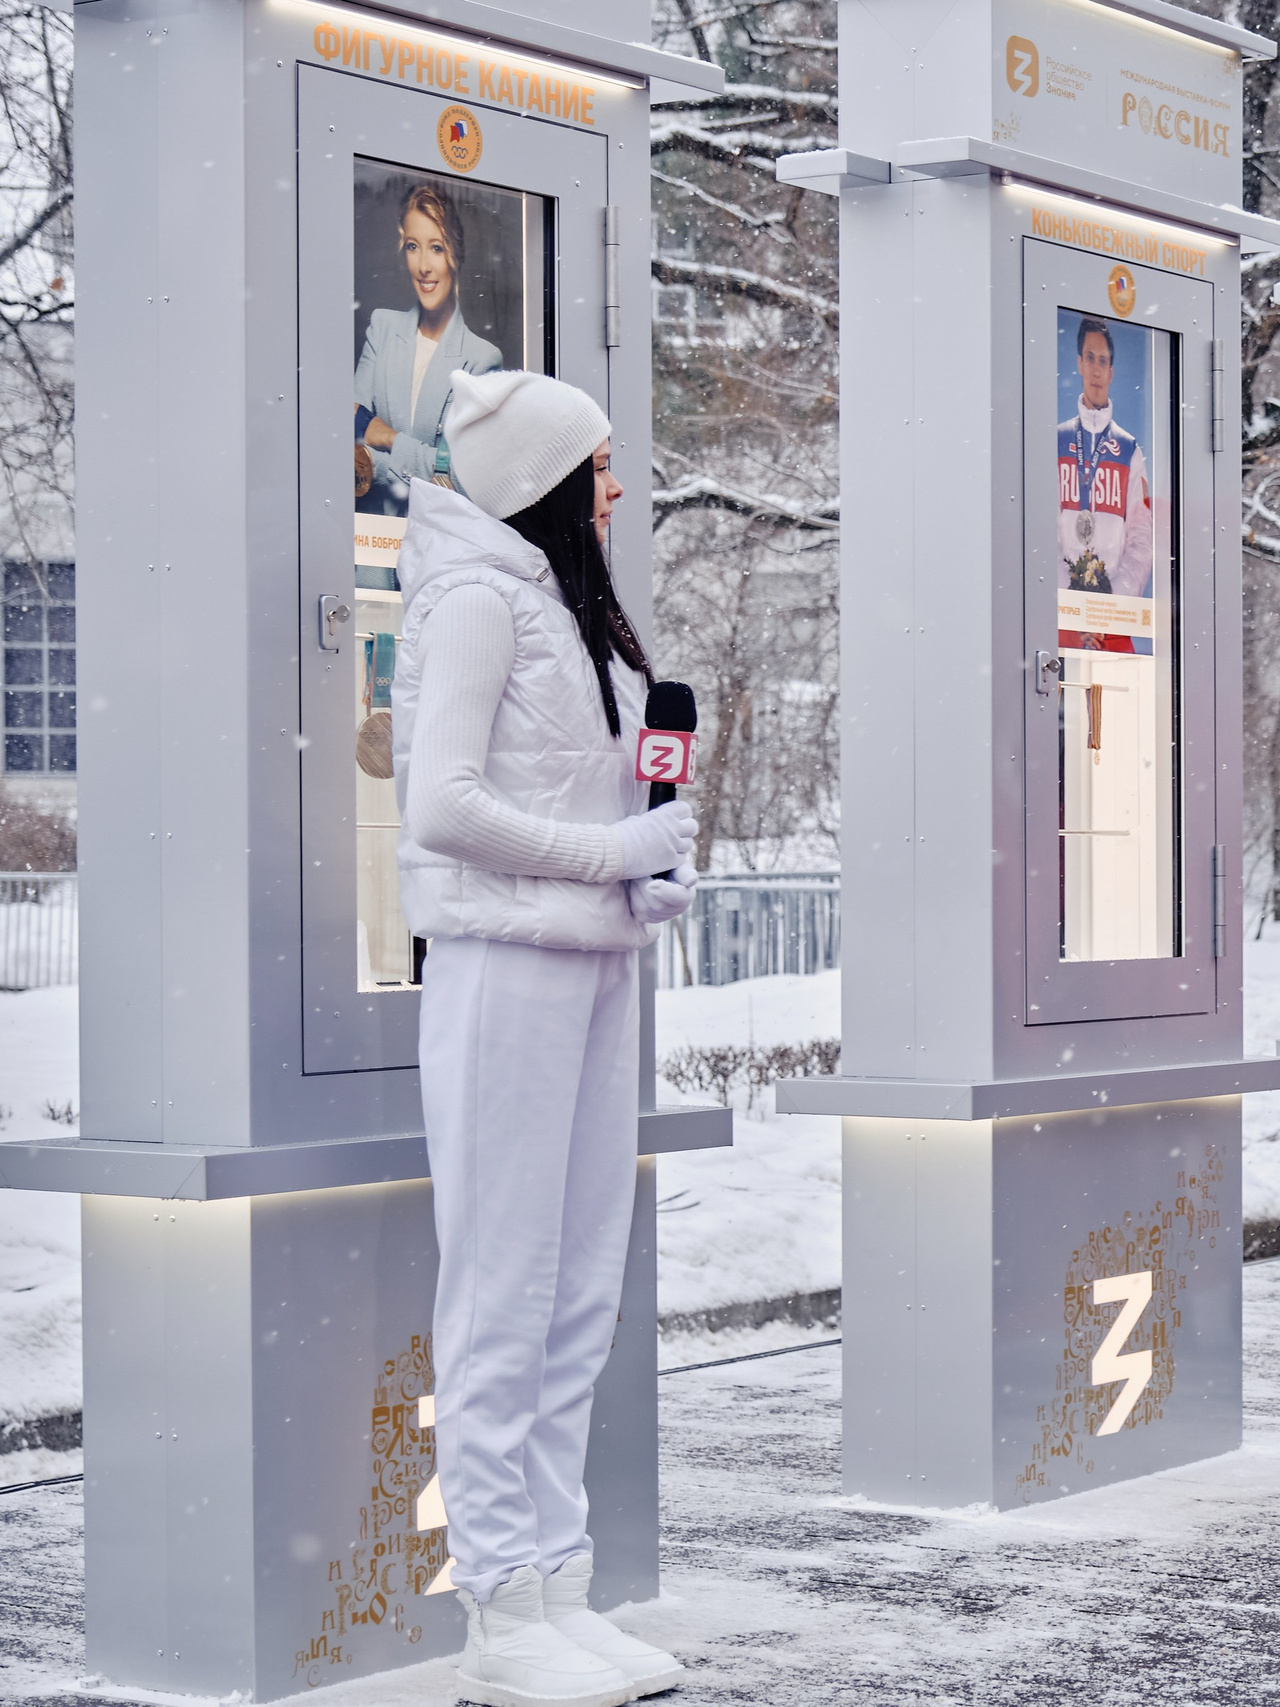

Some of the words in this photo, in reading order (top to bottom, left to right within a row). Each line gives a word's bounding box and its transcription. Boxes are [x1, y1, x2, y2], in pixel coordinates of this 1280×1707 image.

[313, 21, 469, 95] ФИГУРНОЕ
[479, 62, 596, 126] КАТАНИЕ
[1046, 56, 1092, 82] Российское
[1046, 71, 1084, 92] общество
[1120, 68, 1175, 93] МЕЖДУНАРОДНАЯ
[1046, 83, 1077, 102] Знание
[1120, 91, 1231, 158] РОССИЯ
[1032, 207, 1159, 264] КОНЬКОБЕЖНЫЙ
[1162, 241, 1206, 276] СПОРТ
